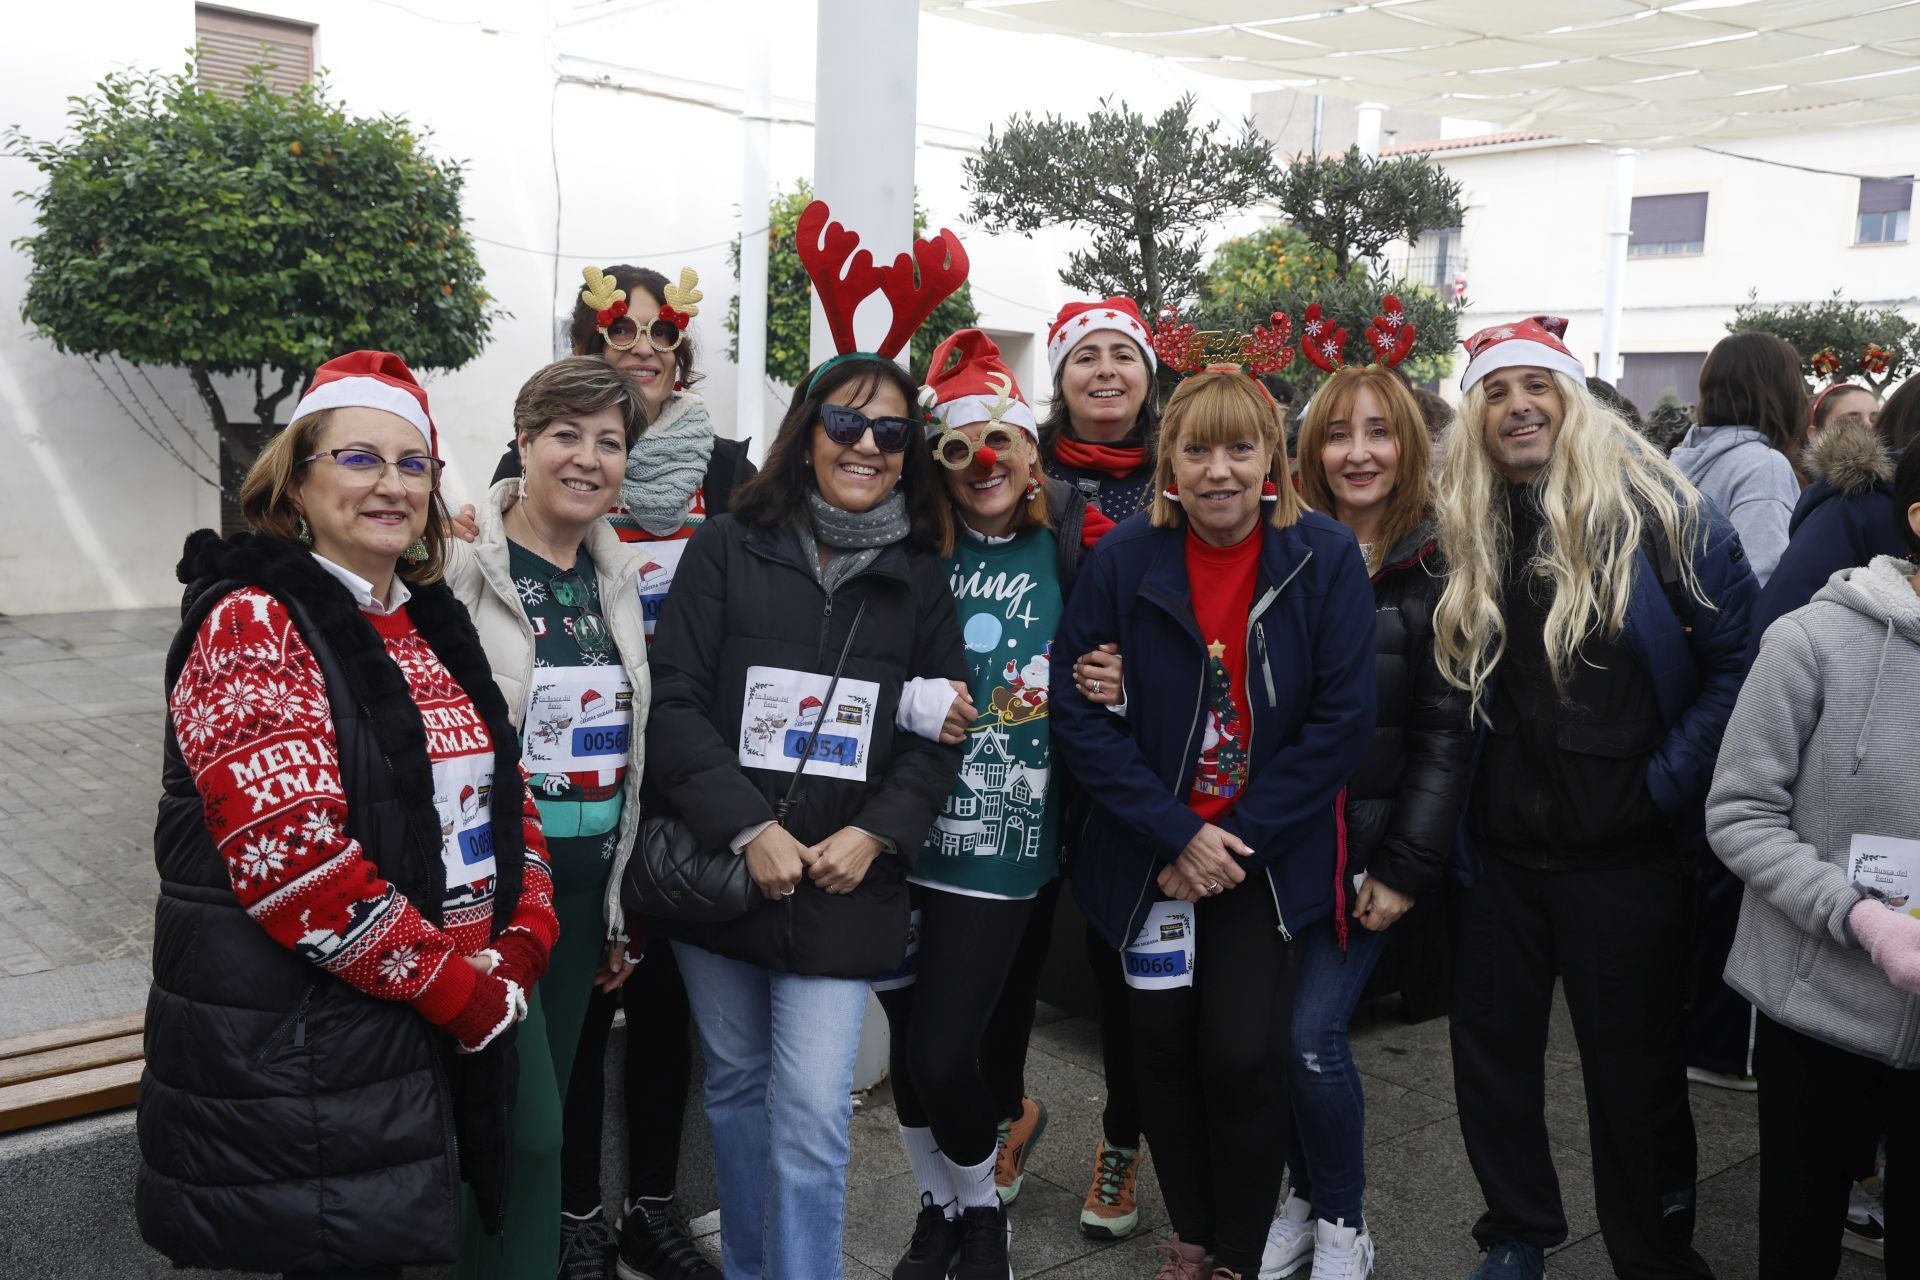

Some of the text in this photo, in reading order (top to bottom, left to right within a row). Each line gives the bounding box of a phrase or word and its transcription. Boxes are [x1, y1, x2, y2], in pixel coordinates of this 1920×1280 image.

[425, 726, 489, 753] XMAS
[583, 731, 625, 752] 0056
[795, 736, 845, 758] 0054
[244, 768, 344, 814] XMA
[1130, 956, 1175, 974] 0066
